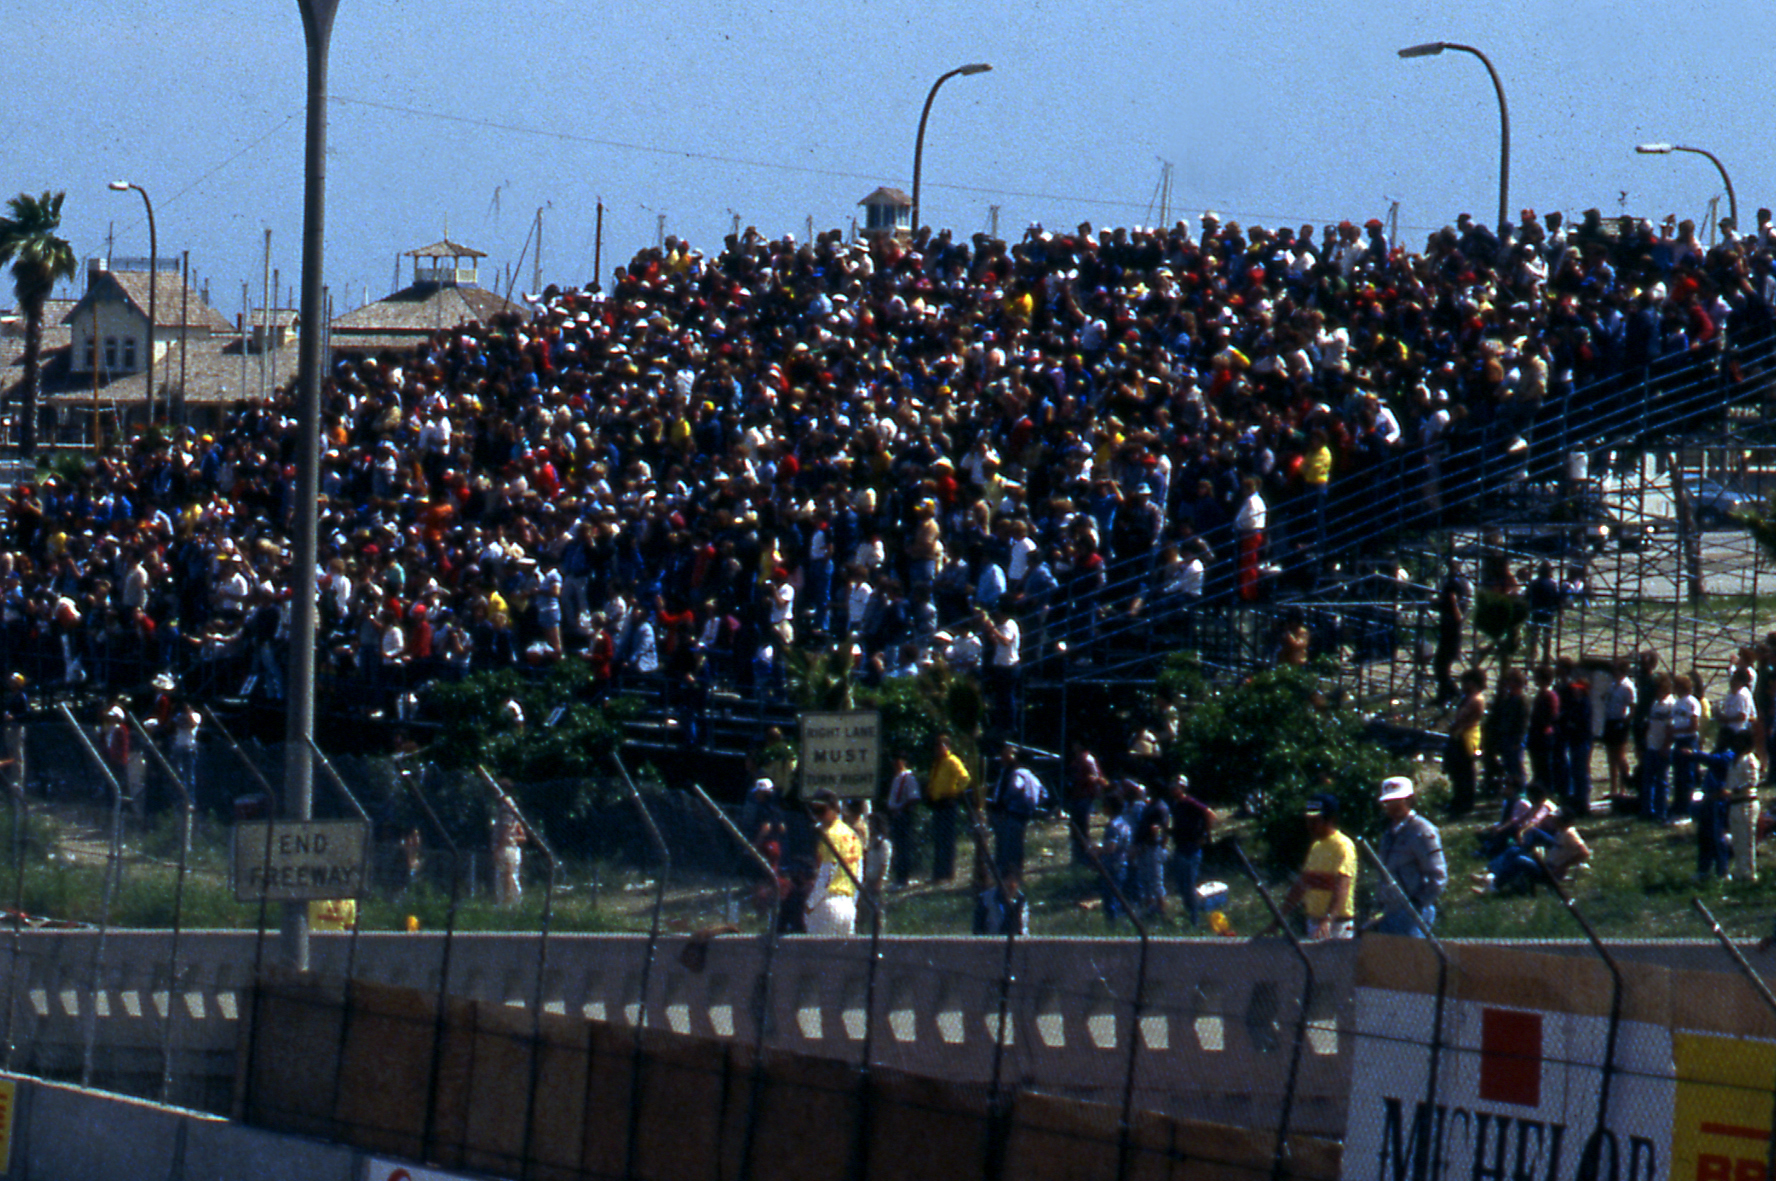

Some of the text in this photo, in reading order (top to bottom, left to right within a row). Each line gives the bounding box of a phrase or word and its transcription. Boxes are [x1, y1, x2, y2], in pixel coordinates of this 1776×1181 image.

[814, 749, 867, 762] MUST
[280, 833, 328, 854] END
[250, 864, 357, 886] FREEWAY
